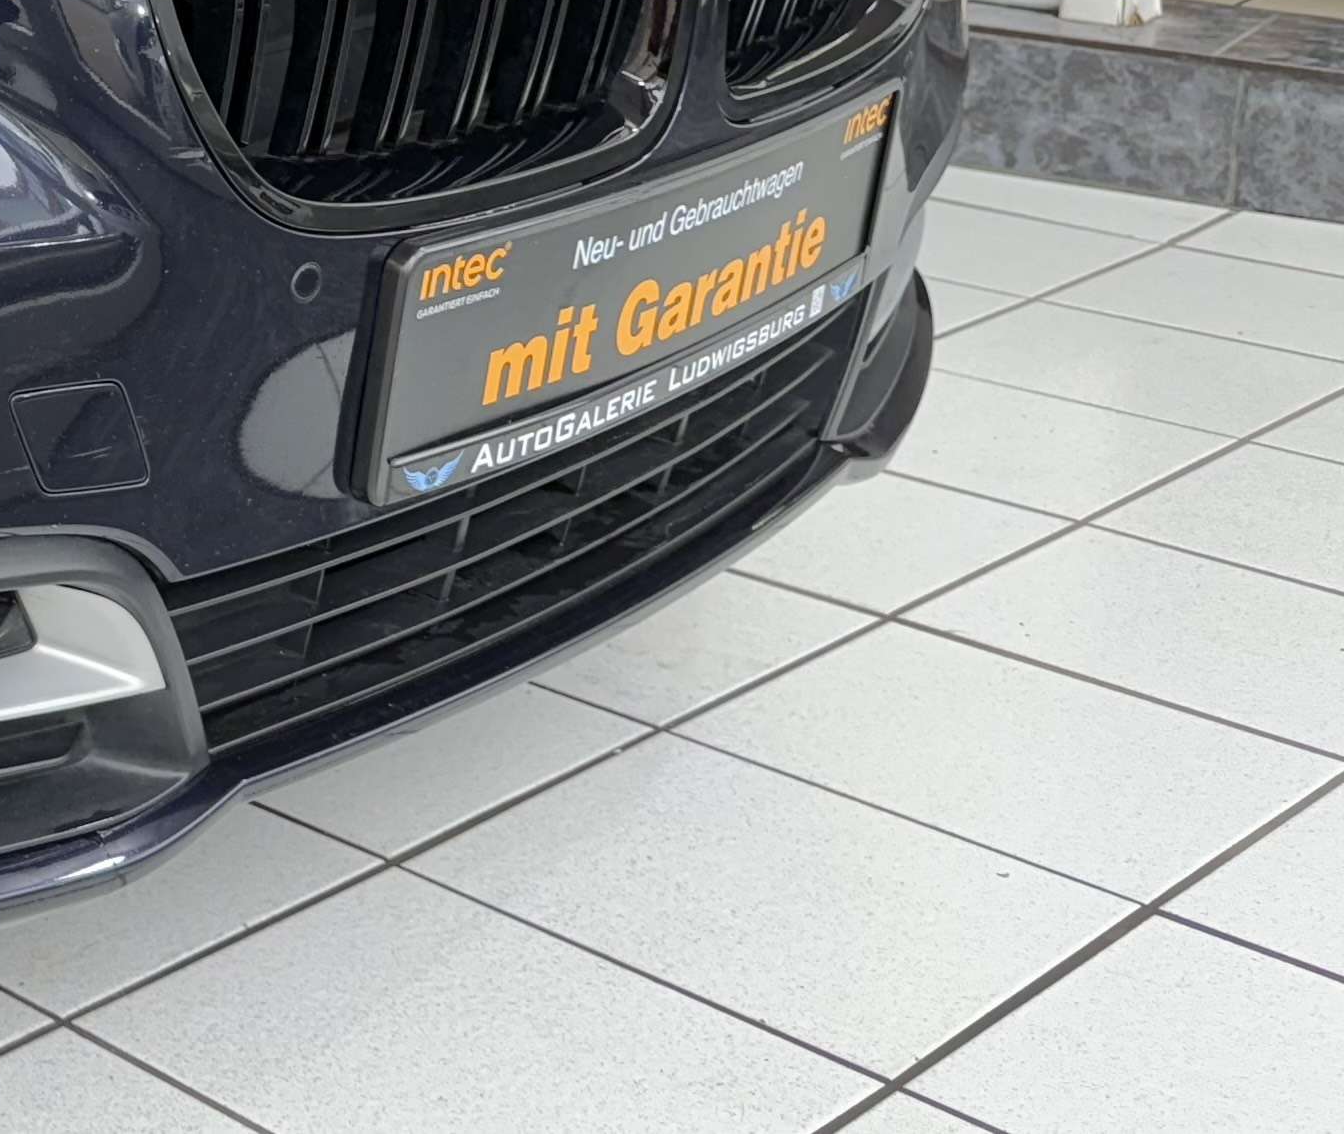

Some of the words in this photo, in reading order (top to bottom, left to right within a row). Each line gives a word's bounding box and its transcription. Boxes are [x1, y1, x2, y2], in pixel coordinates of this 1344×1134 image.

[572, 236, 623, 269] Neu-
[629, 211, 668, 251] und
[670, 160, 804, 237] Gebrauchtwagen
[482, 303, 598, 406] mit
[616, 208, 828, 356] Garantie
[668, 304, 805, 392] LUDWIGSBURG
